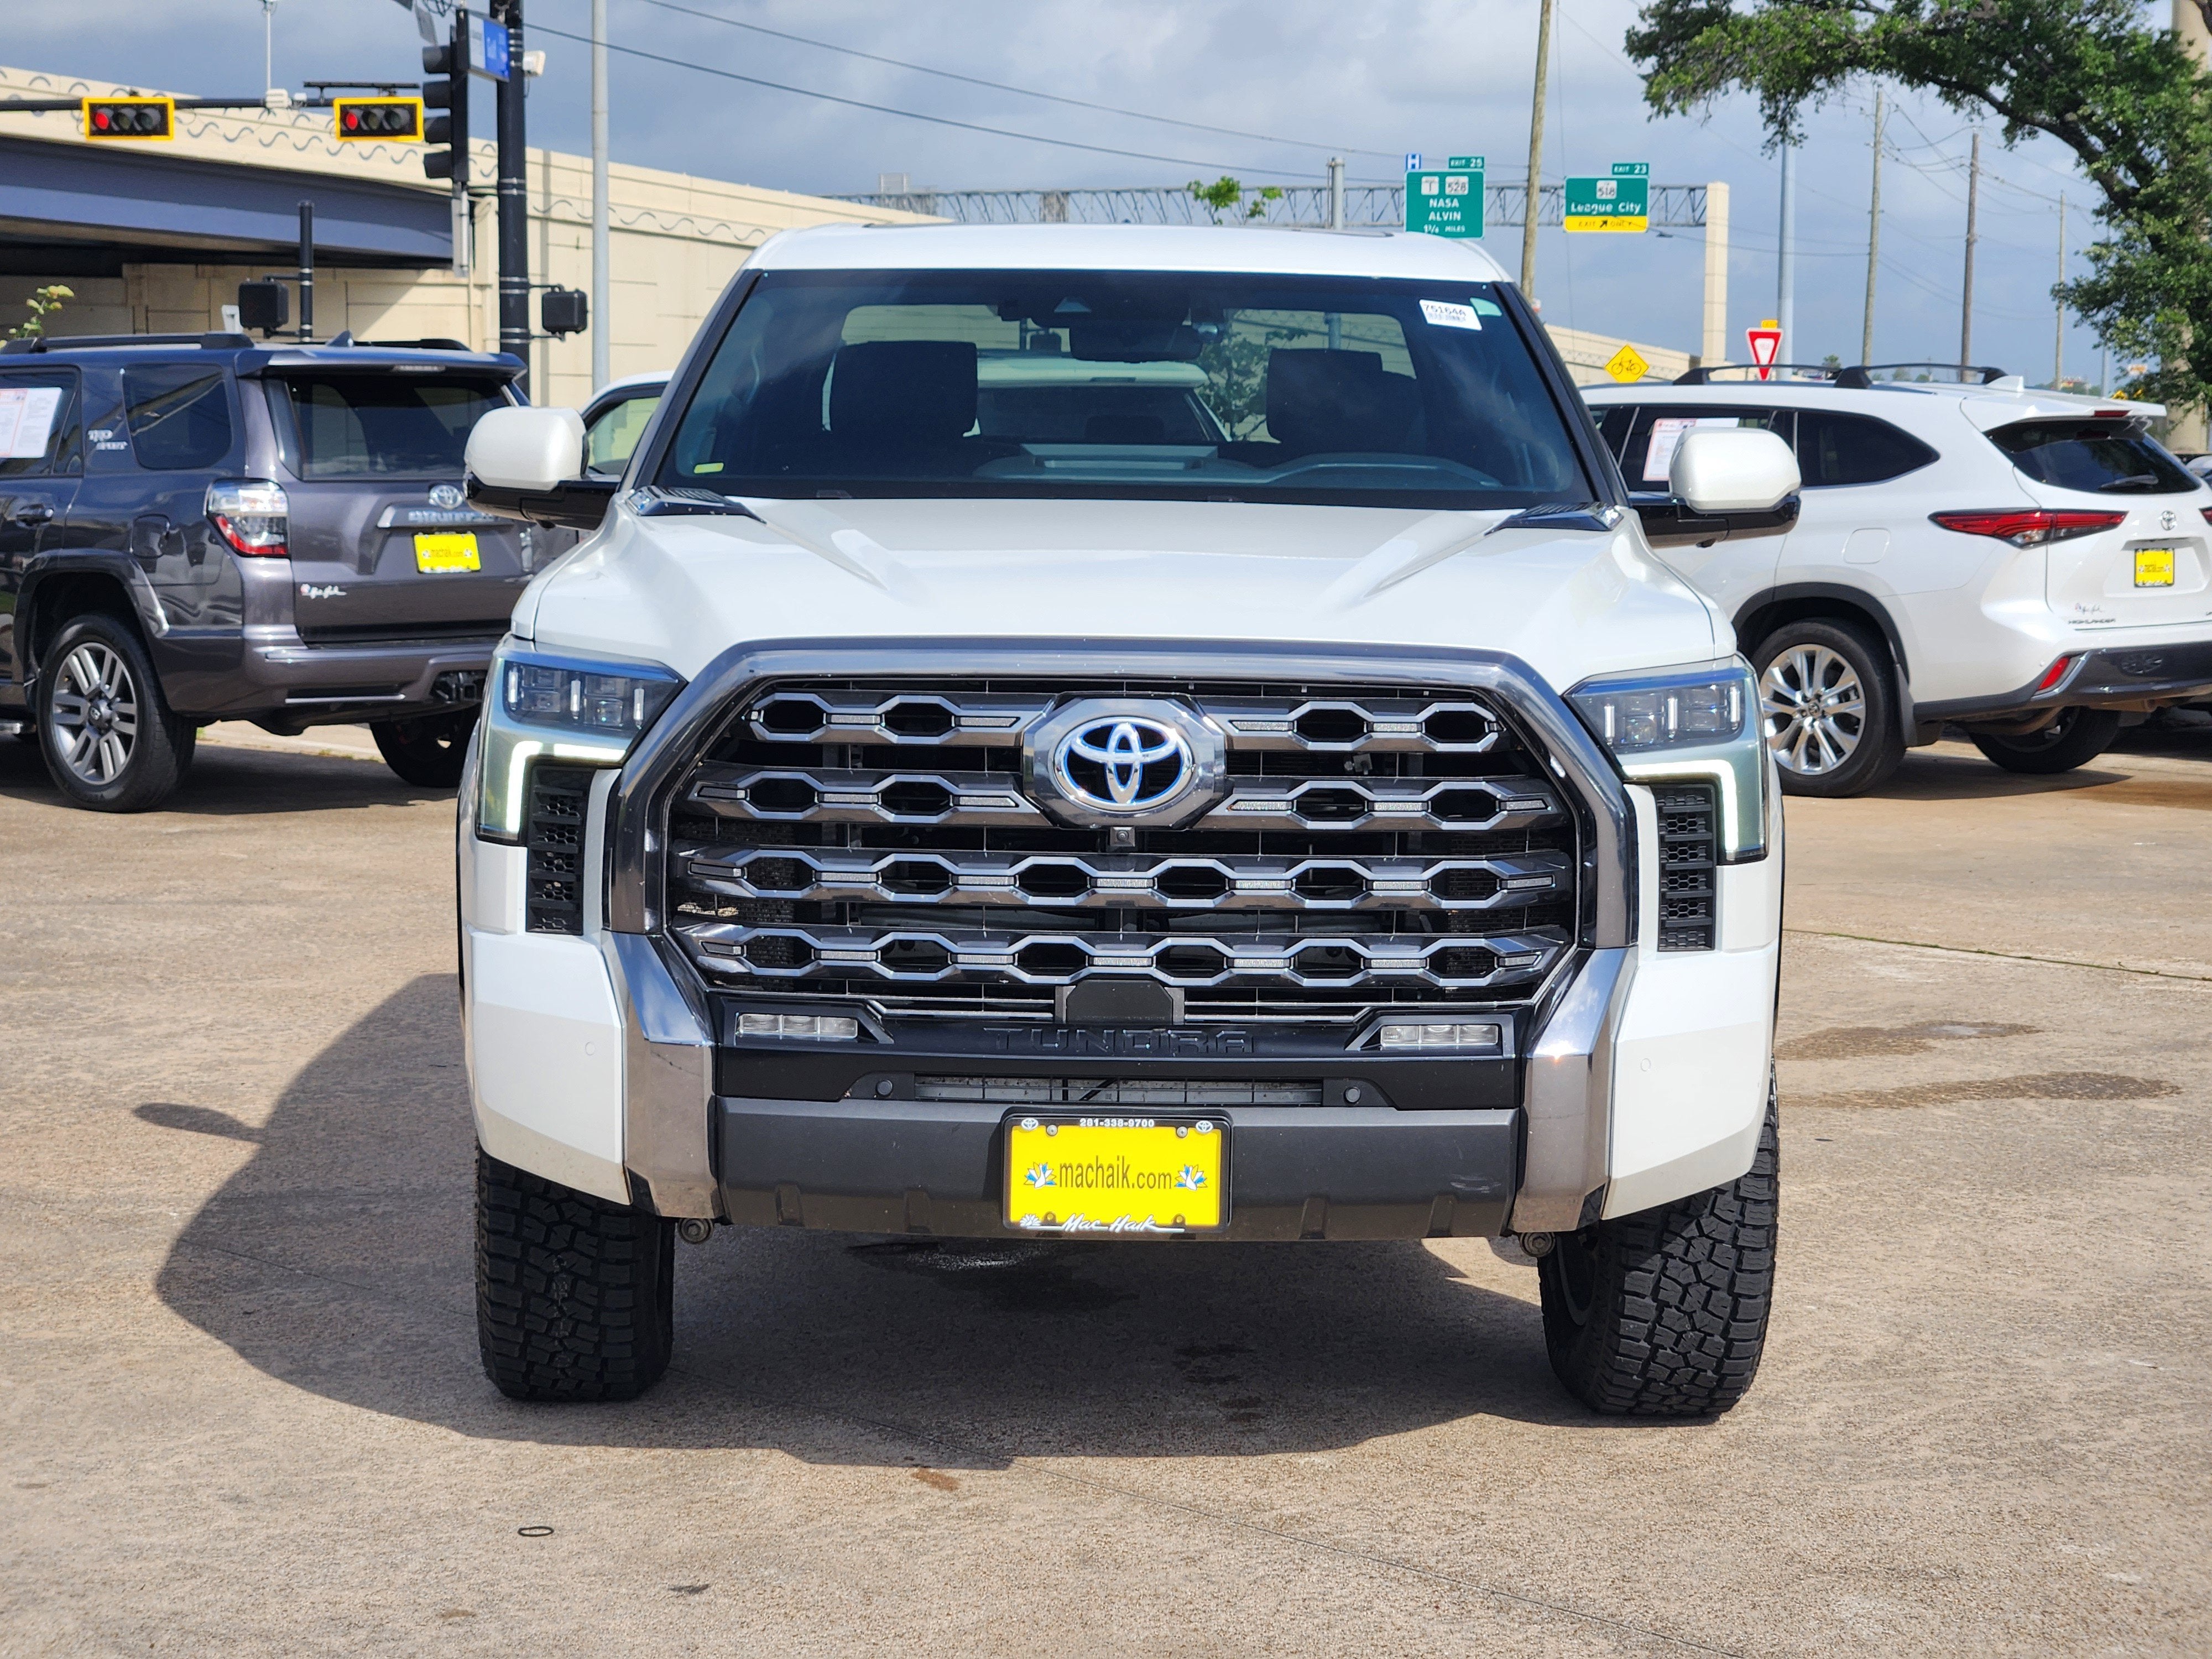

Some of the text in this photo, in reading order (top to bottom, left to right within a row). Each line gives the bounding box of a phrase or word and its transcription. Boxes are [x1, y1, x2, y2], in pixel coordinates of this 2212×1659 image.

[1470, 158, 1482, 168] 25
[1634, 164, 1647, 174] 23
[1447, 181, 1467, 193] 528
[1429, 197, 1459, 208] NASA
[1571, 201, 1641, 215] League City
[1428, 211, 1461, 221] ALVIN
[983, 1026, 1255, 1055] TUNDRA
[1079, 1118, 1155, 1127] 281-338-9700
[1058, 1155, 1172, 1190] machaik.com
[1061, 1213, 1156, 1233] Mac Haik
